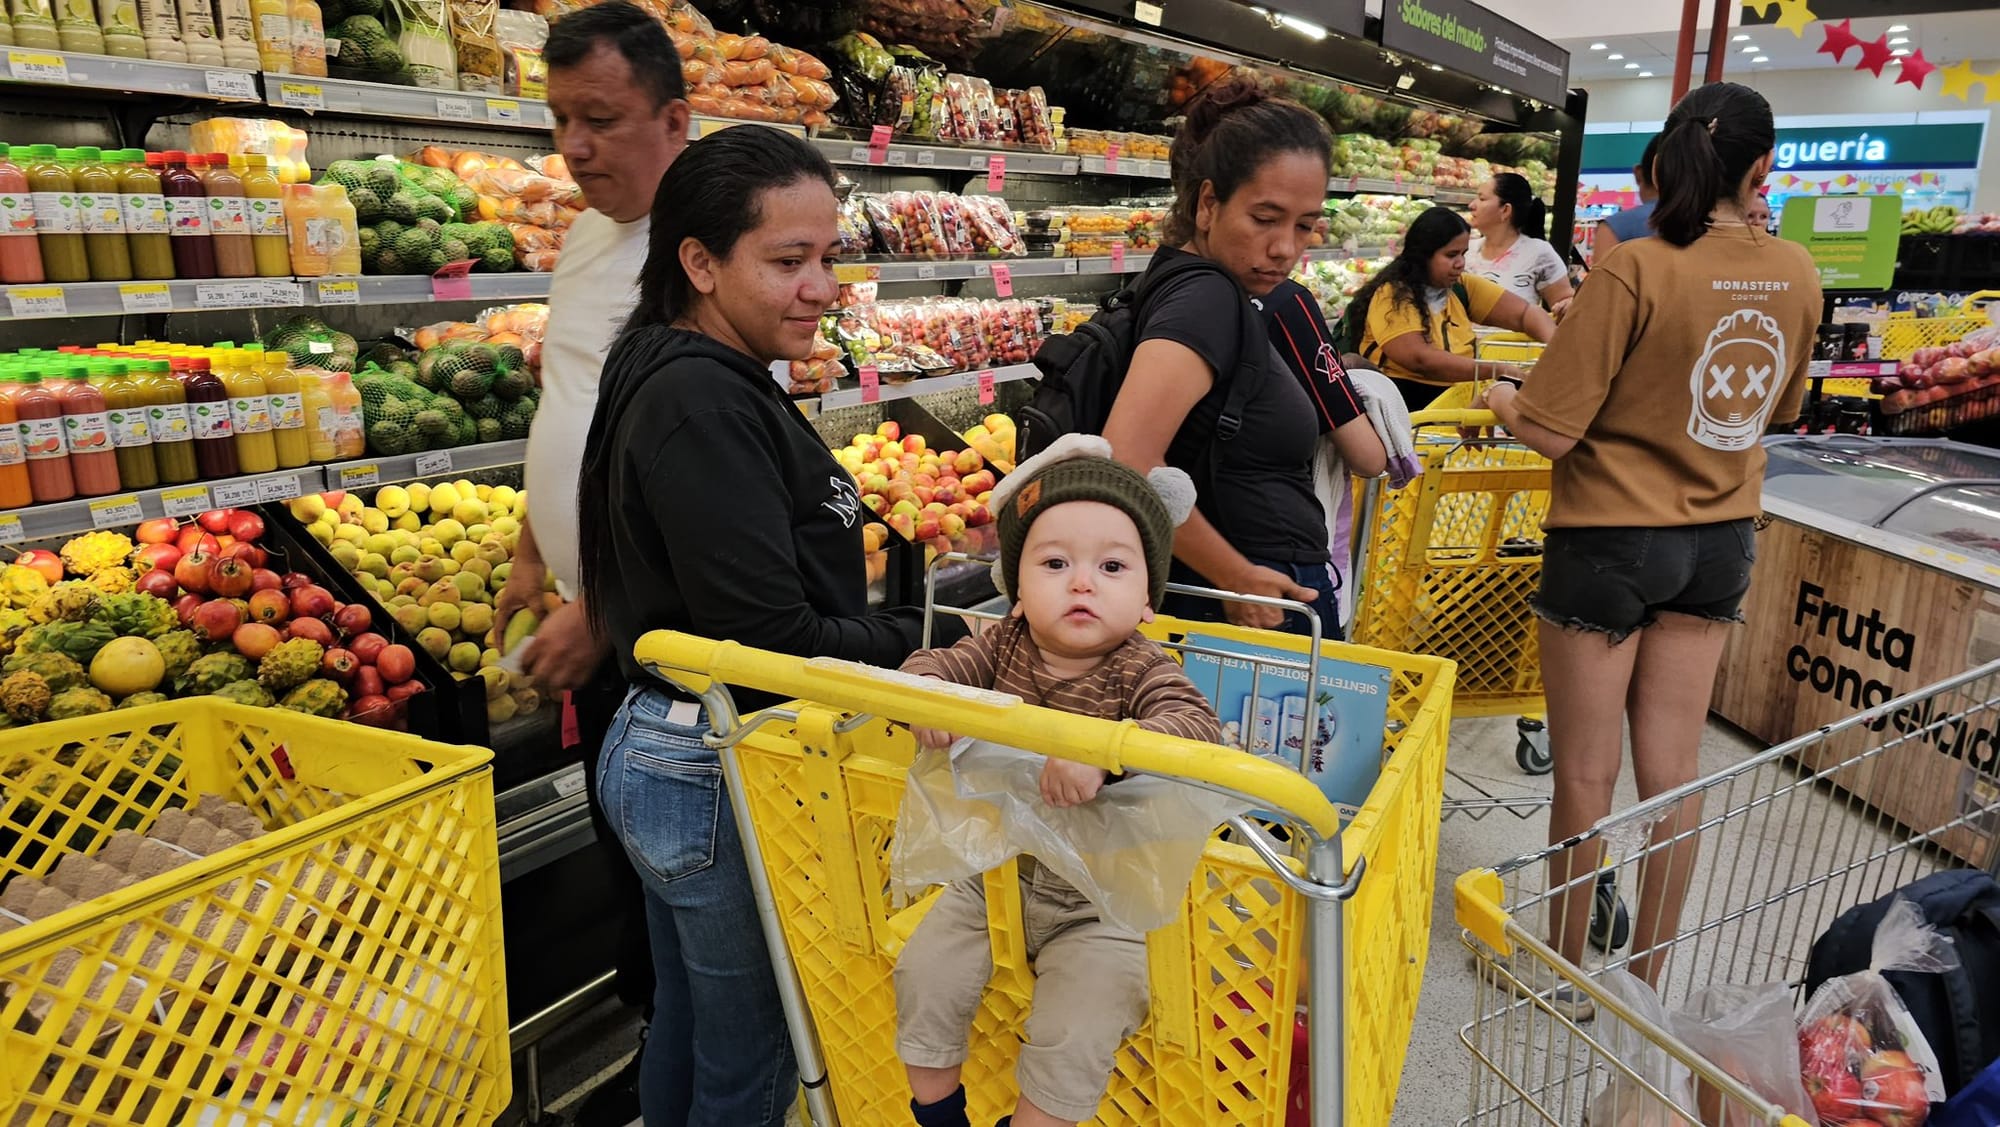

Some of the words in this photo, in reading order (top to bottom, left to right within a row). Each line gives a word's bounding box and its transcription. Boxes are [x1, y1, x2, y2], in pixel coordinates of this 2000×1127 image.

[1442, 13, 1457, 41] del
[1456, 27, 1484, 53] mundo
[1774, 132, 1887, 168] guería
[1712, 280, 1790, 291] MONASTERY
[1731, 293, 1769, 301] COUTURE
[1794, 580, 1915, 672] Fruta
[1239, 660, 1248, 670] Y
[1319, 674, 1379, 695] SIÉNTETE
